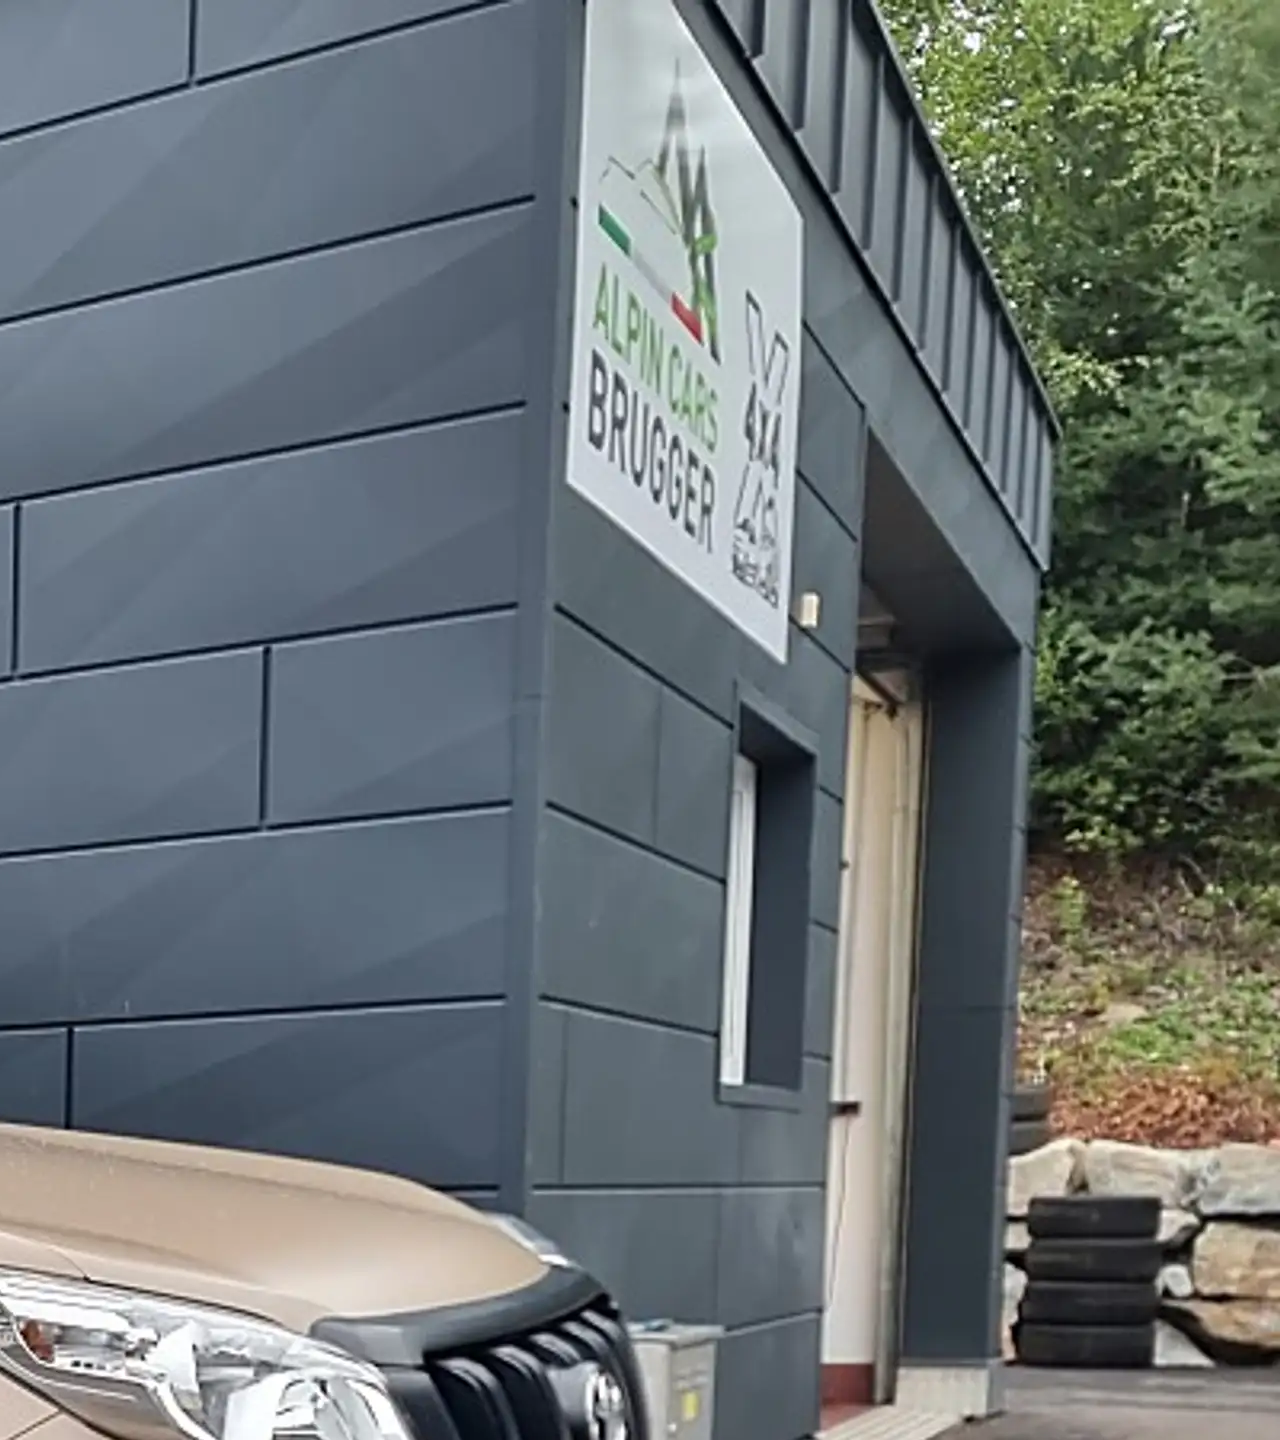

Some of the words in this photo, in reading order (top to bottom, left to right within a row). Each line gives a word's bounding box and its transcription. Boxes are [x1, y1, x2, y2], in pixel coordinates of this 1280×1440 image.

[589, 348, 716, 553] BRUGGER
[593, 262, 663, 395] ALPIN
[669, 344, 718, 452] CARS
